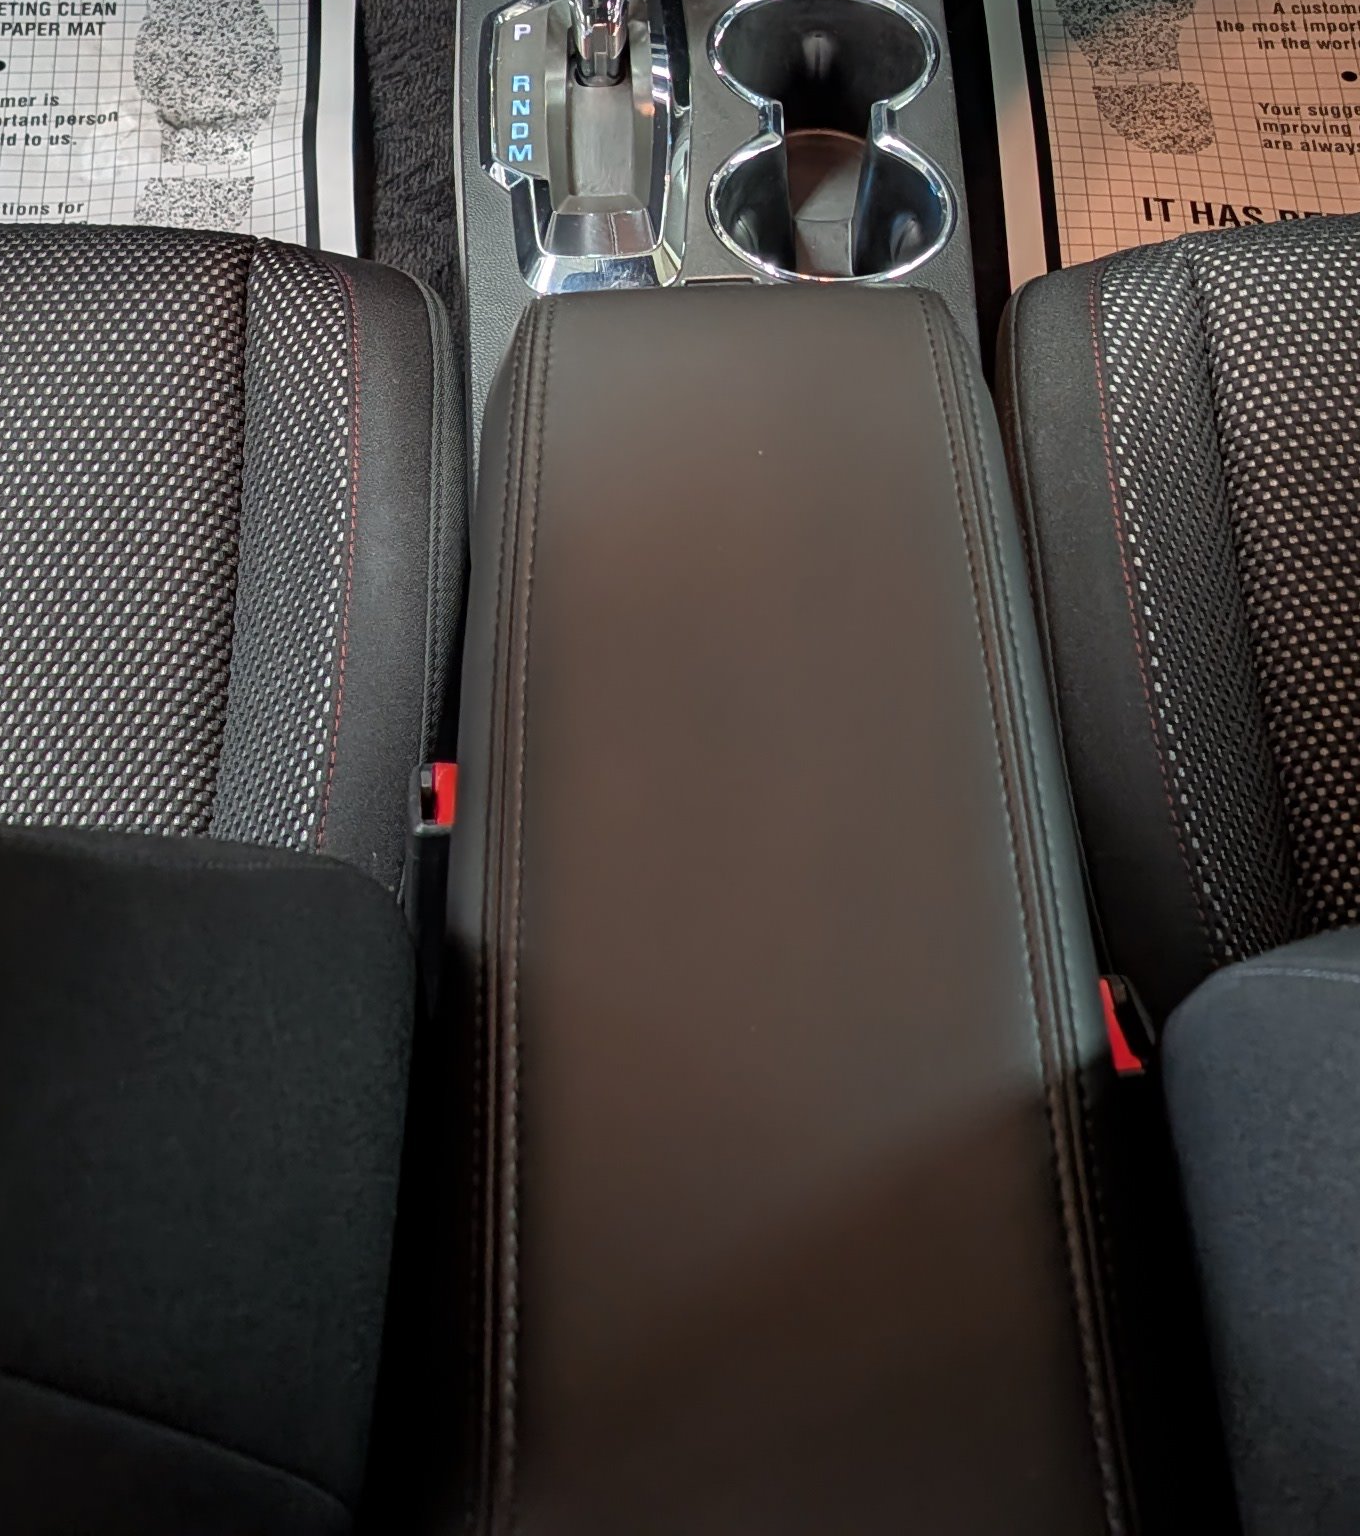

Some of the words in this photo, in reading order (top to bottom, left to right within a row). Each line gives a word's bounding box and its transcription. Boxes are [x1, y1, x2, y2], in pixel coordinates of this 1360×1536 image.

[58, 1, 117, 16] CLEAN
[1273, 2, 1285, 15] A
[1, 22, 60, 37] PAPER
[67, 22, 107, 36] MAT
[513, 23, 531, 41] P
[1216, 19, 1245, 33] the
[1252, 20, 1297, 33] most
[1257, 37, 1275, 50] in
[1281, 37, 1310, 50] the
[512, 75, 531, 93] R
[43, 93, 60, 107] is
[512, 100, 530, 116] N
[1258, 102, 1301, 116] Your
[55, 110, 118, 127] person
[511, 122, 528, 140] D
[1256, 118, 1352, 137] improving
[24, 133, 42, 146] to
[49, 133, 78, 146] us.
[1262, 138, 1293, 150] are
[508, 144, 532, 162] M
[57, 201, 85, 214] for
[1142, 197, 1175, 223] IT
[1191, 200, 1265, 228] HAS
